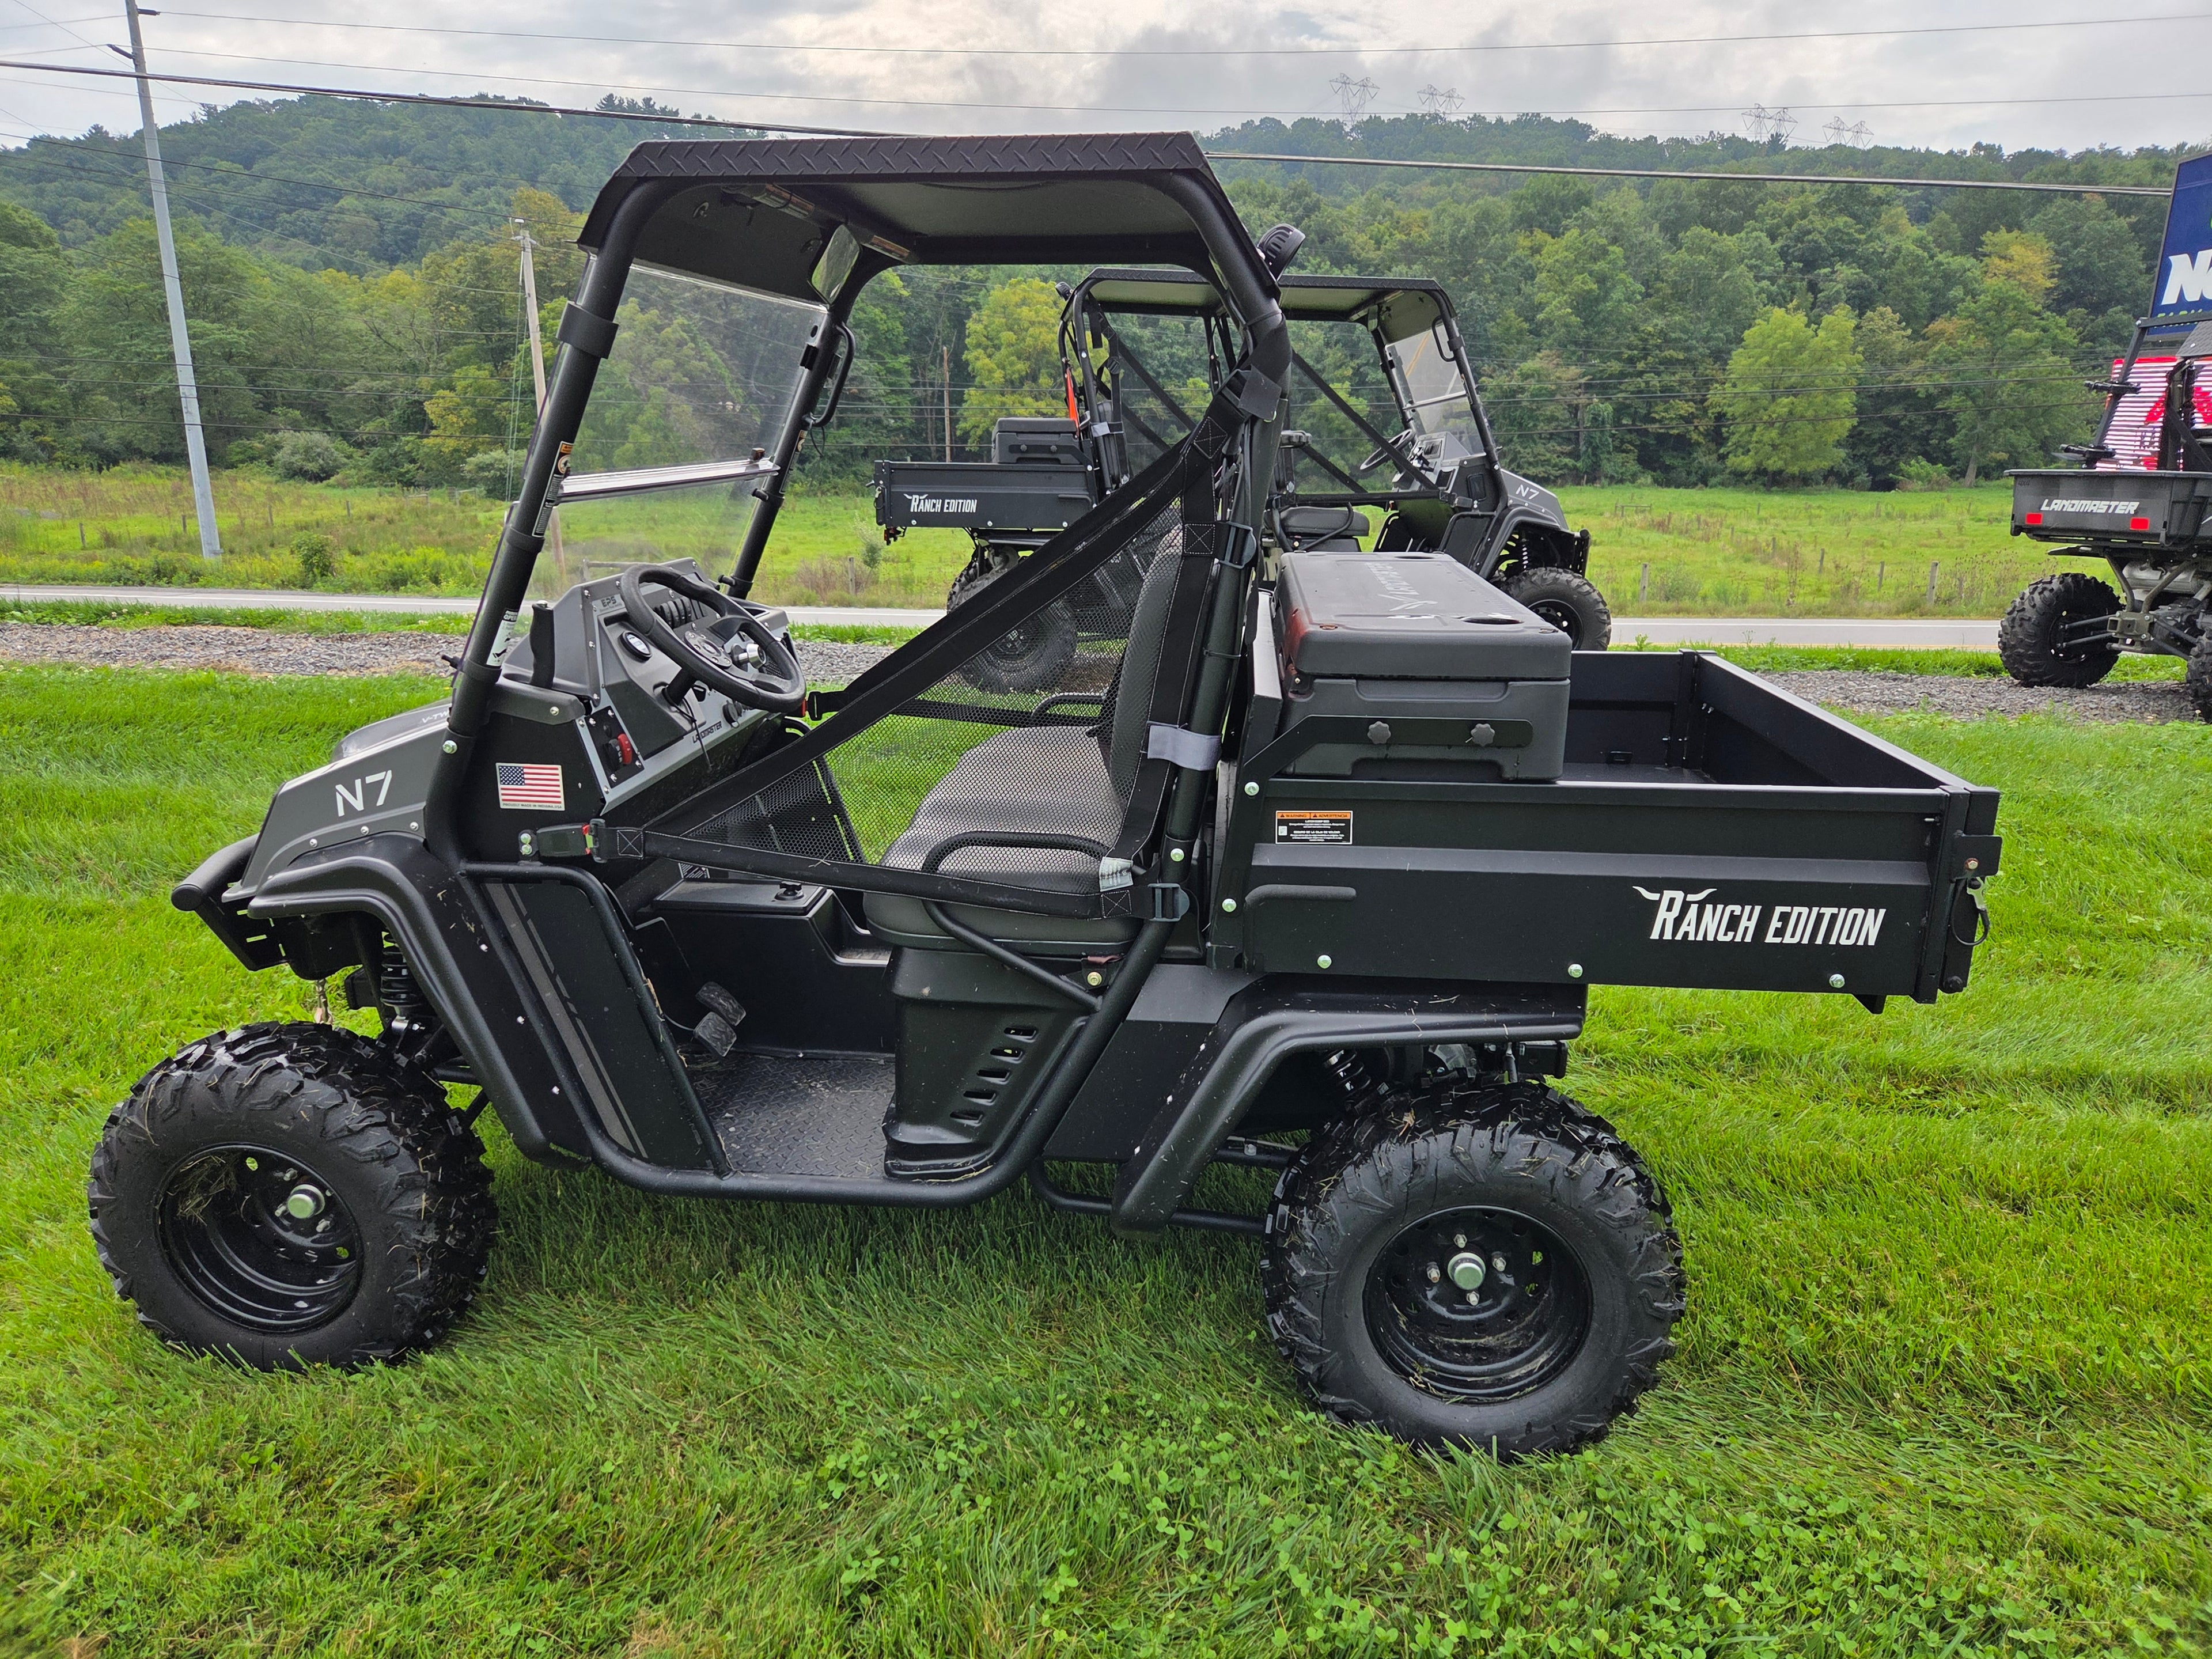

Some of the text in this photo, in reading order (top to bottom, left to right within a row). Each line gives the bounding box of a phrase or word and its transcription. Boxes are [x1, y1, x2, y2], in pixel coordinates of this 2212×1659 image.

[2161, 249, 2212, 305] N
[1516, 484, 1540, 500] N7
[910, 495, 978, 513] RANCH EDITION
[2040, 499, 2140, 514] LANDMASTER
[601, 596, 617, 608] EPS
[335, 770, 392, 817] N7
[1649, 890, 1887, 946] RANCH EDITION
